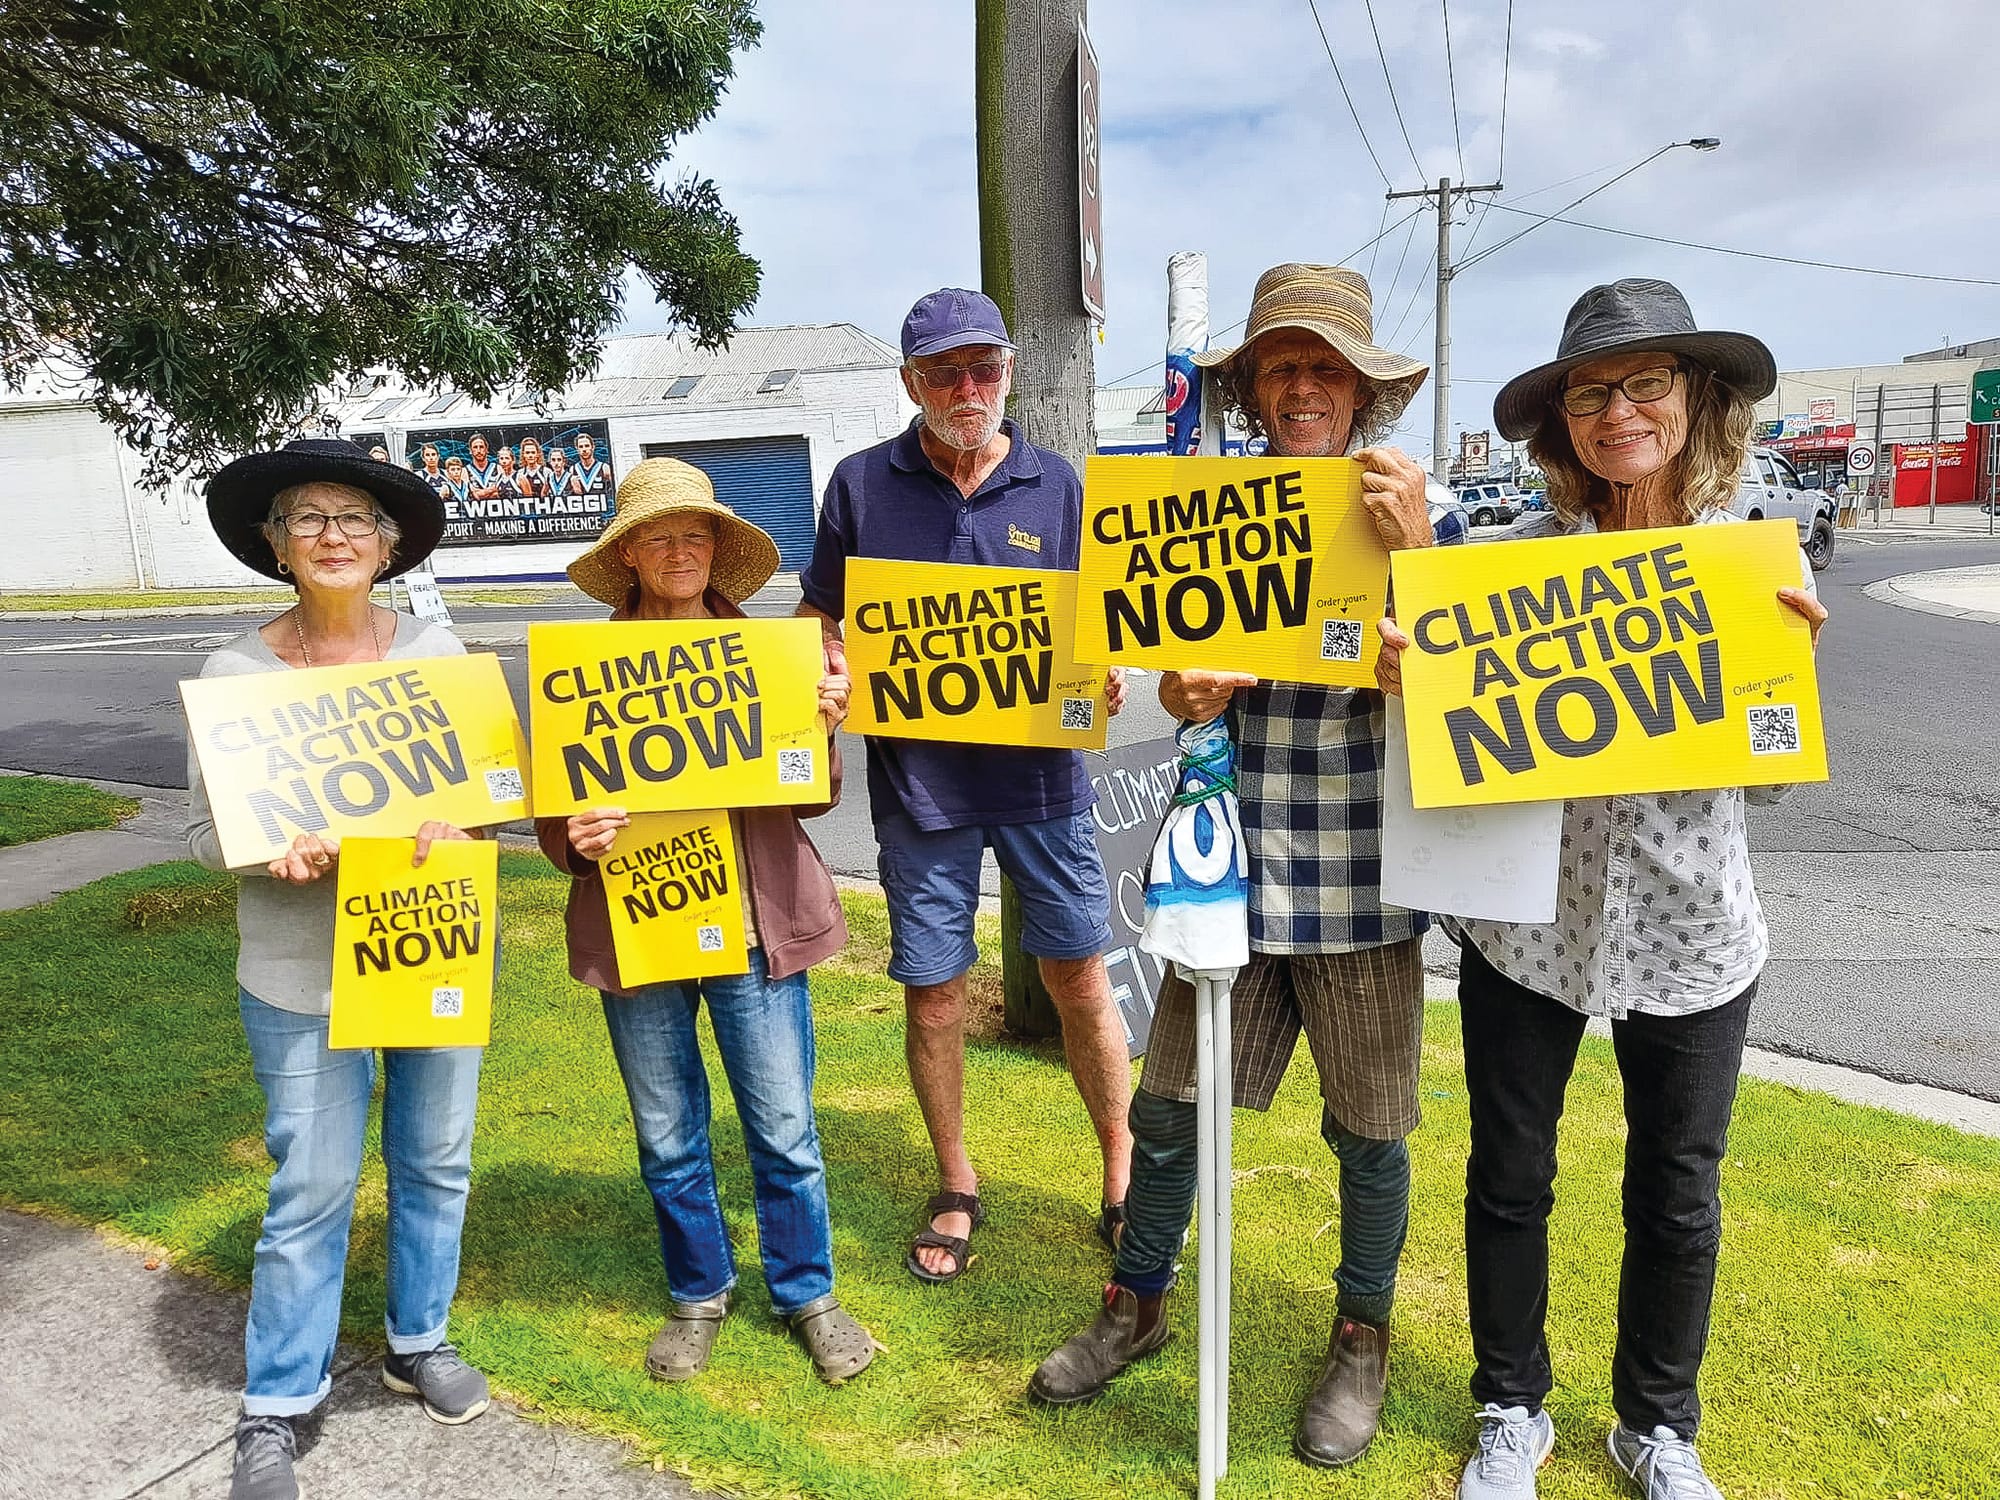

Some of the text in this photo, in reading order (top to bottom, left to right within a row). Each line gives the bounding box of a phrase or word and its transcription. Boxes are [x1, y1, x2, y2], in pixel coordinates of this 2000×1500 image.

[1853, 453, 1870, 465] 50
[463, 494, 607, 518] WONTHAGGI
[485, 519, 526, 536] MAKING
[529, 519, 537, 533] A
[538, 517, 602, 532] DIFFERENCE
[1092, 470, 1306, 545] CLIMATE
[1124, 514, 1312, 583] ACTION
[854, 581, 1046, 634] CLIMATE
[1103, 556, 1313, 653] NOW
[1316, 594, 1368, 608] Order yours
[1413, 542, 1695, 655] CLIMATE
[542, 632, 748, 704] CLIMATE
[888, 616, 1052, 666] ACTION
[1472, 589, 1715, 698] ACTION
[210, 670, 431, 752] CLIMATE
[583, 666, 759, 736] ACTION
[868, 650, 1054, 723] NOW
[1444, 639, 1725, 787] NOW
[1733, 673, 1794, 696] Order yours
[265, 700, 451, 780] ACTION
[562, 702, 762, 802] NOW
[247, 731, 469, 846] NOW
[605, 826, 715, 876] CLIMATE
[631, 844, 723, 890] ACTION
[344, 877, 476, 917] CLIMATE
[368, 898, 480, 937] ACTION
[622, 863, 729, 925] NOW
[353, 921, 481, 976] NOW
[1103, 946, 1166, 1043] FI
